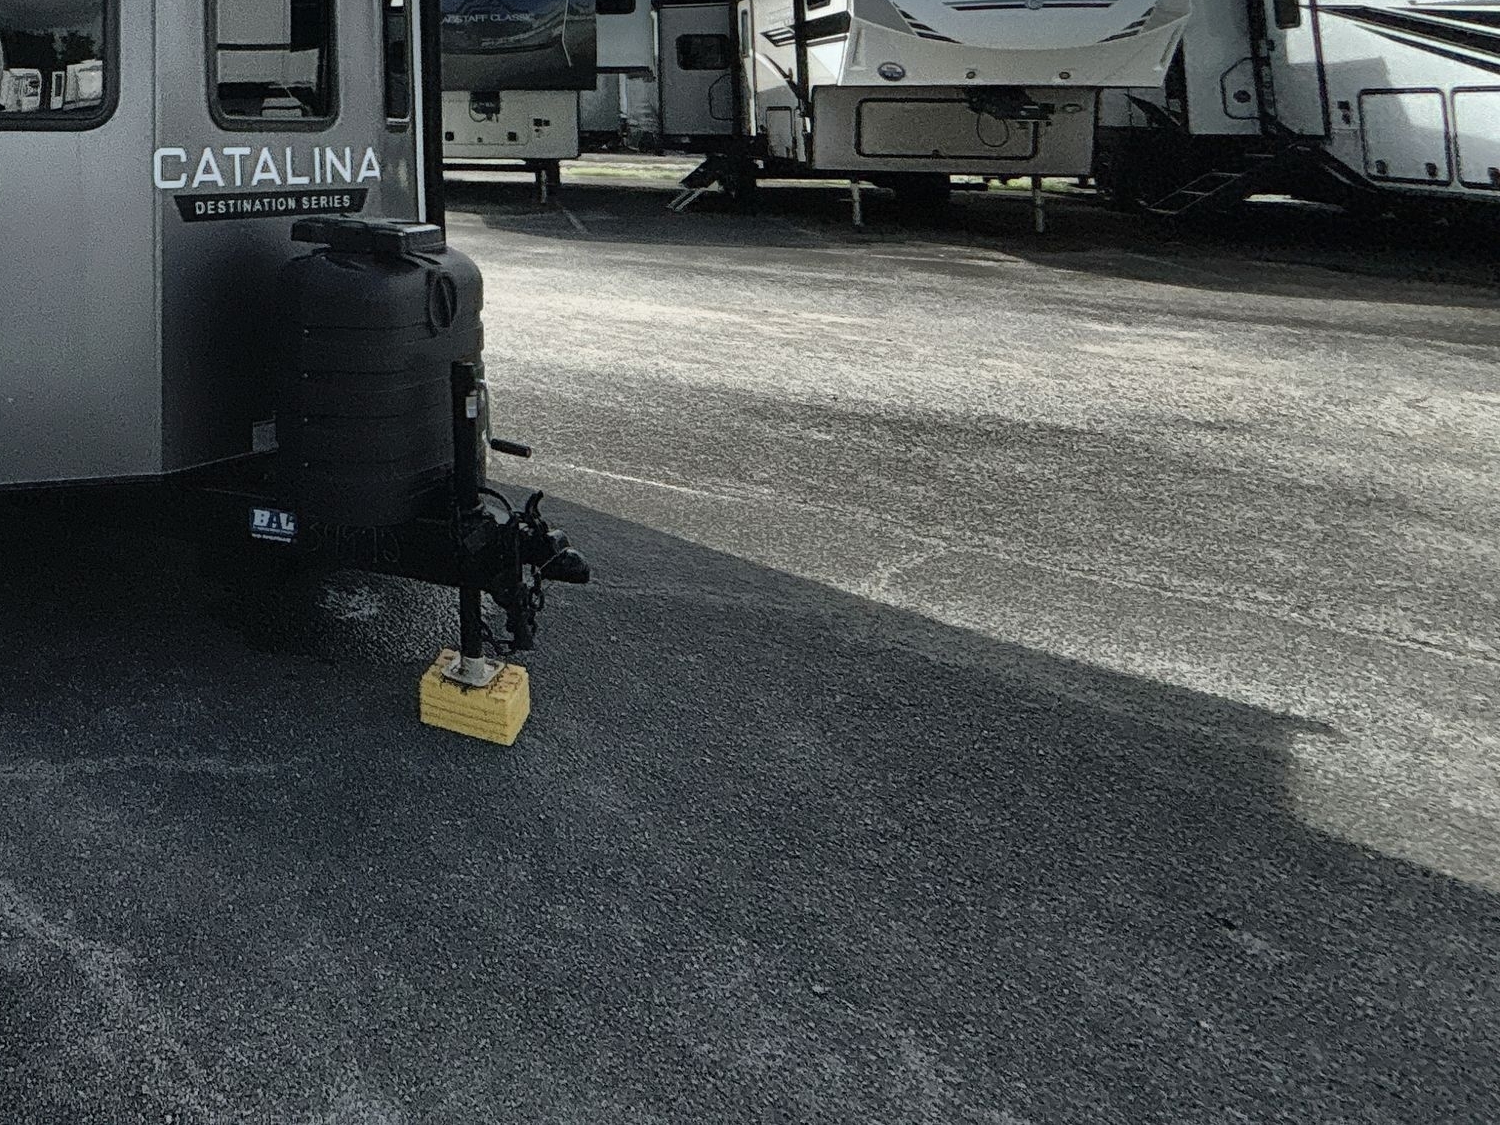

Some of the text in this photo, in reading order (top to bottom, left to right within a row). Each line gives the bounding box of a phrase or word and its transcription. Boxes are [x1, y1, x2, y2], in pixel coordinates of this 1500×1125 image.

[440, 14, 488, 25] AGSTAFF
[153, 146, 382, 190] CATALINA
[194, 194, 351, 216] DESTINATION SERIES
